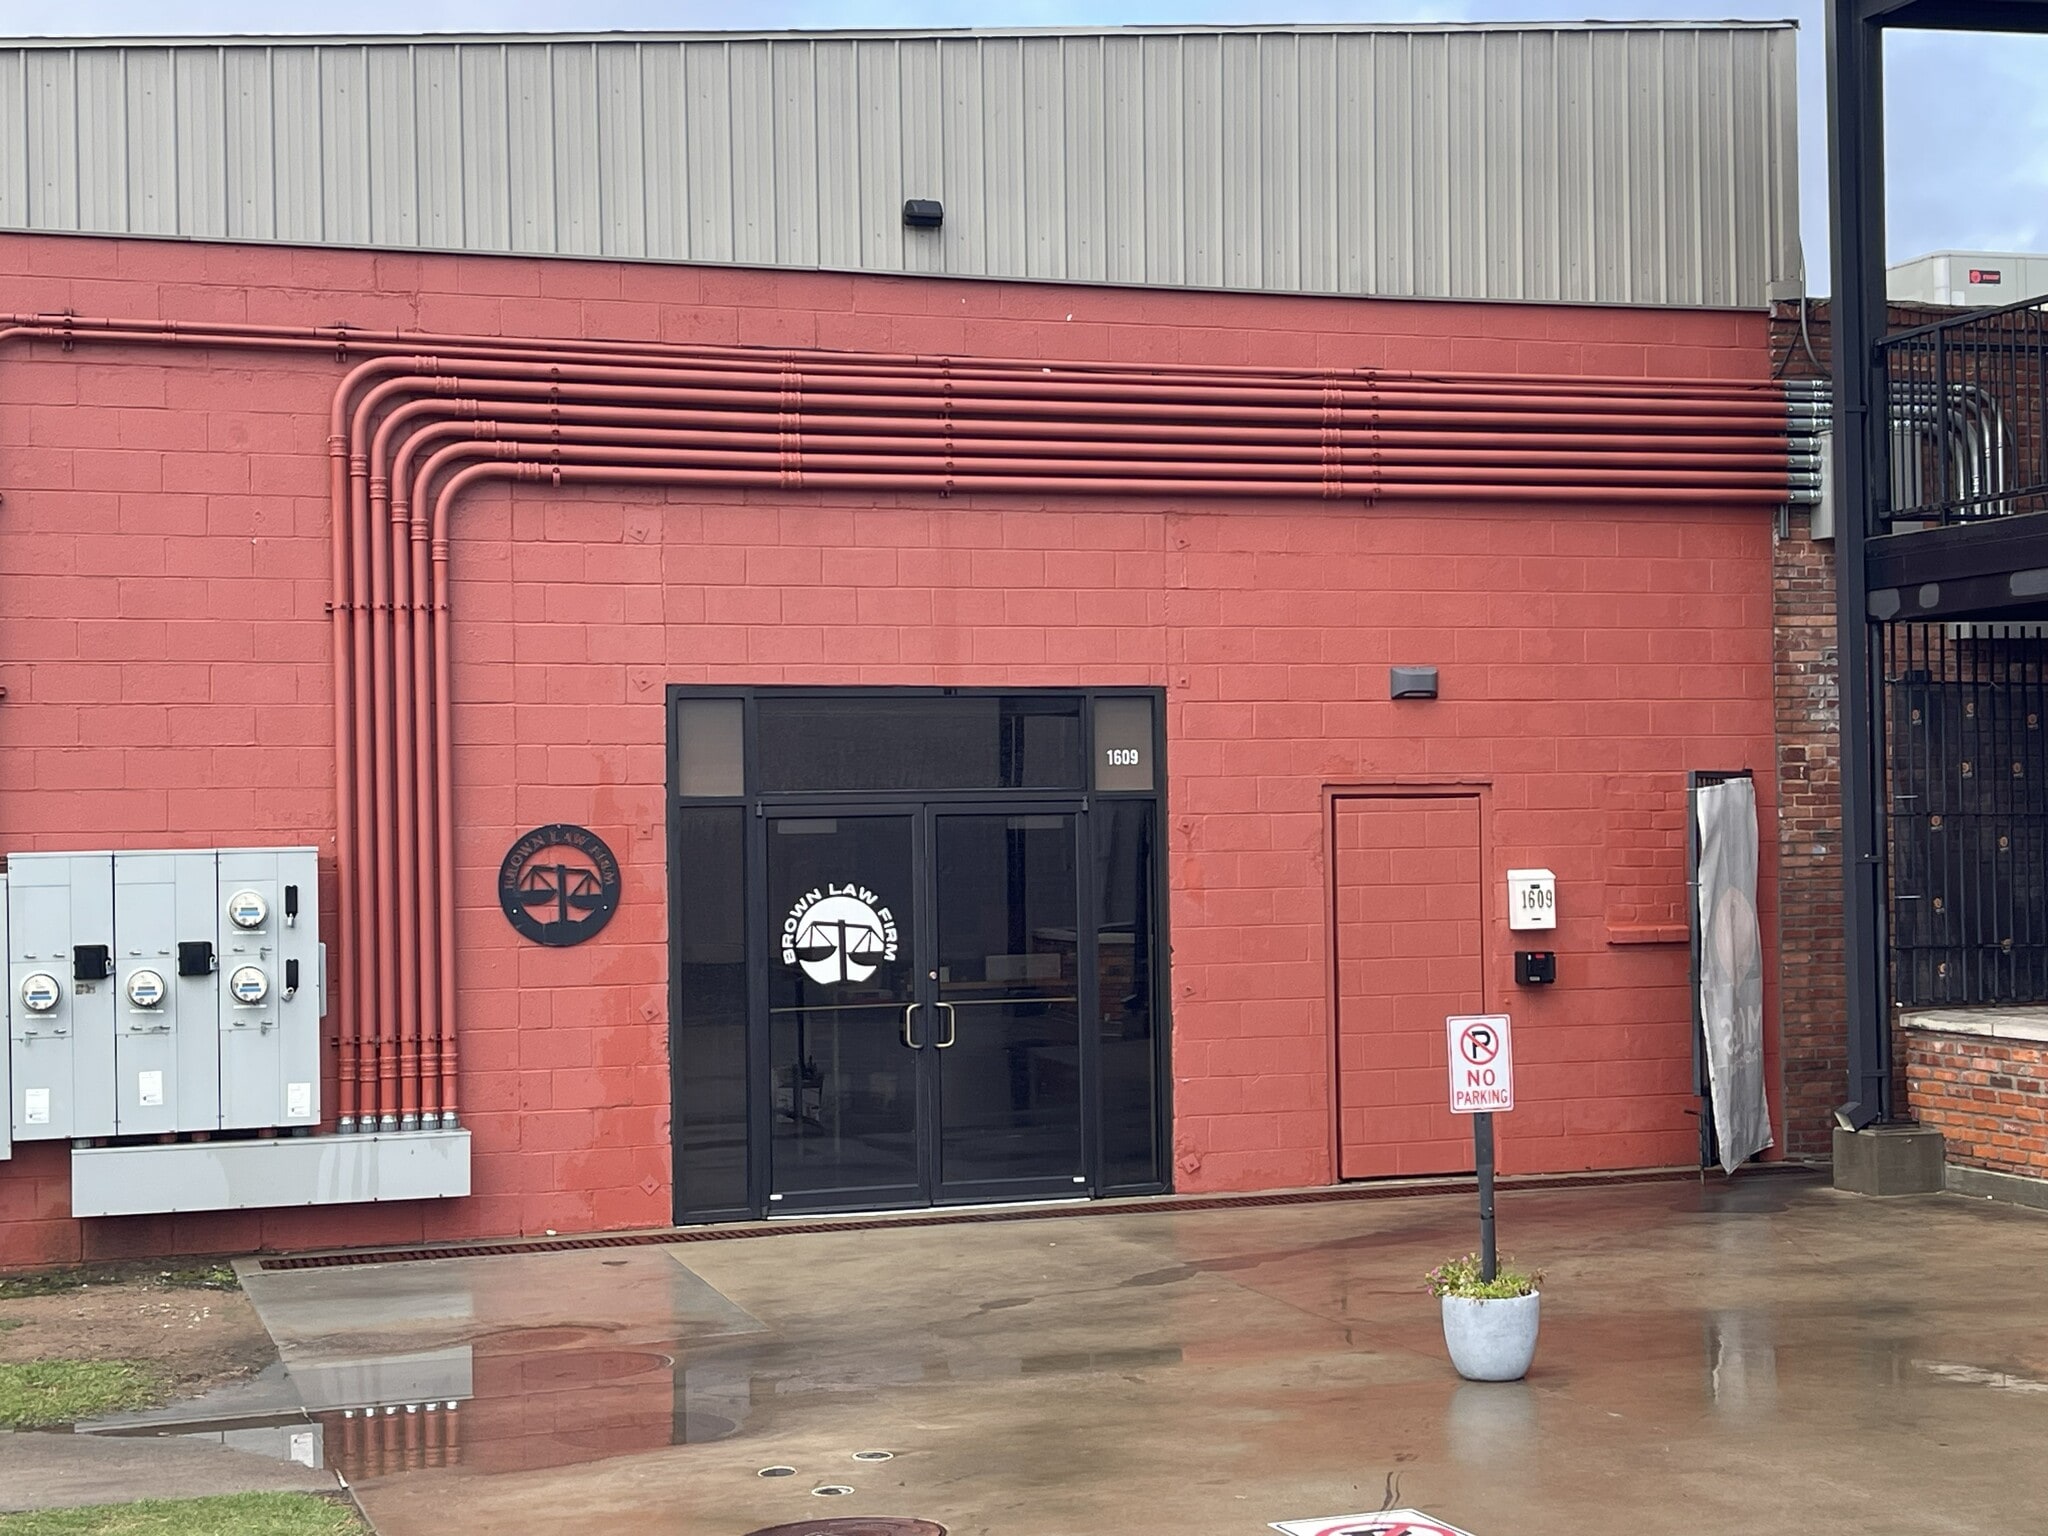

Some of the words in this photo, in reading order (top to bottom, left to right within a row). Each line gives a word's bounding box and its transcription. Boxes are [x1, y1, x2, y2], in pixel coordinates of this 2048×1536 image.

[1106, 749, 1139, 766] 1609
[1522, 889, 1553, 909] 1609
[781, 887, 823, 965] BROWN
[828, 883, 879, 905] LAW
[877, 907, 898, 961] FIRM
[1467, 1069, 1496, 1087] NO
[1456, 1088, 1508, 1106] PARKING
